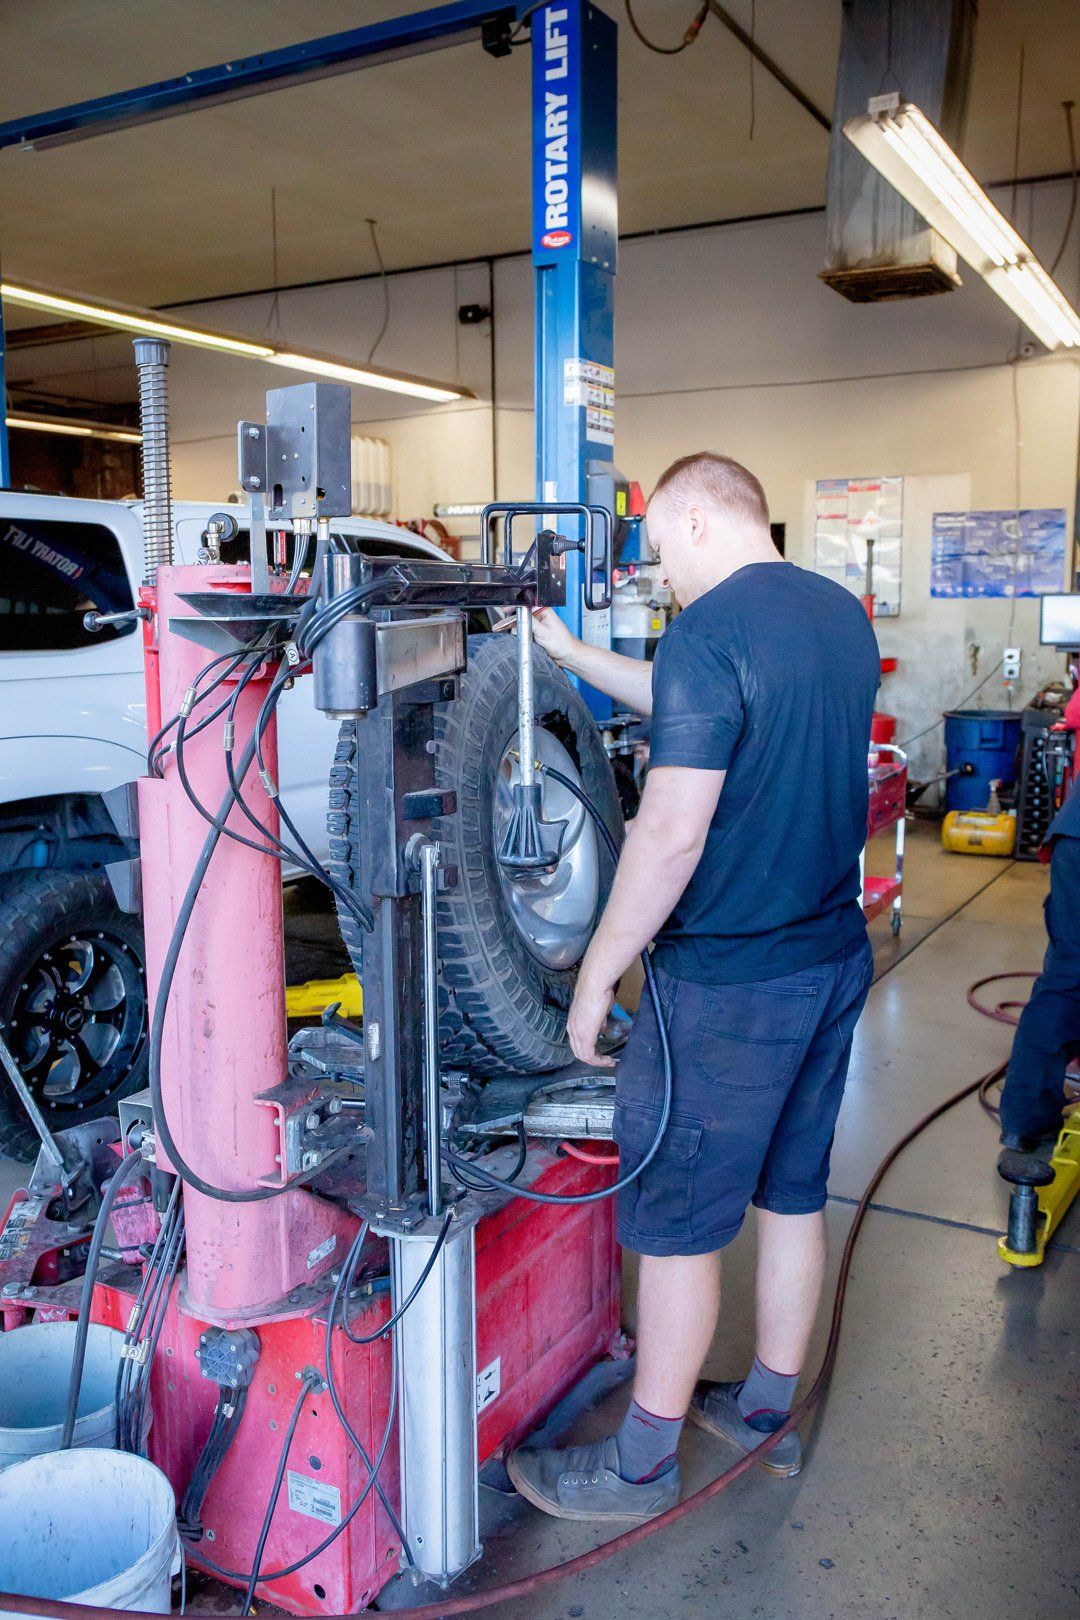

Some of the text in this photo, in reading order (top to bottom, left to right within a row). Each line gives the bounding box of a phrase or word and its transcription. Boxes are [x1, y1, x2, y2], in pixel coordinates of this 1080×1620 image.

[545, 7, 568, 229] ROTARY LIFT
[447, 504, 484, 516] HUNT
